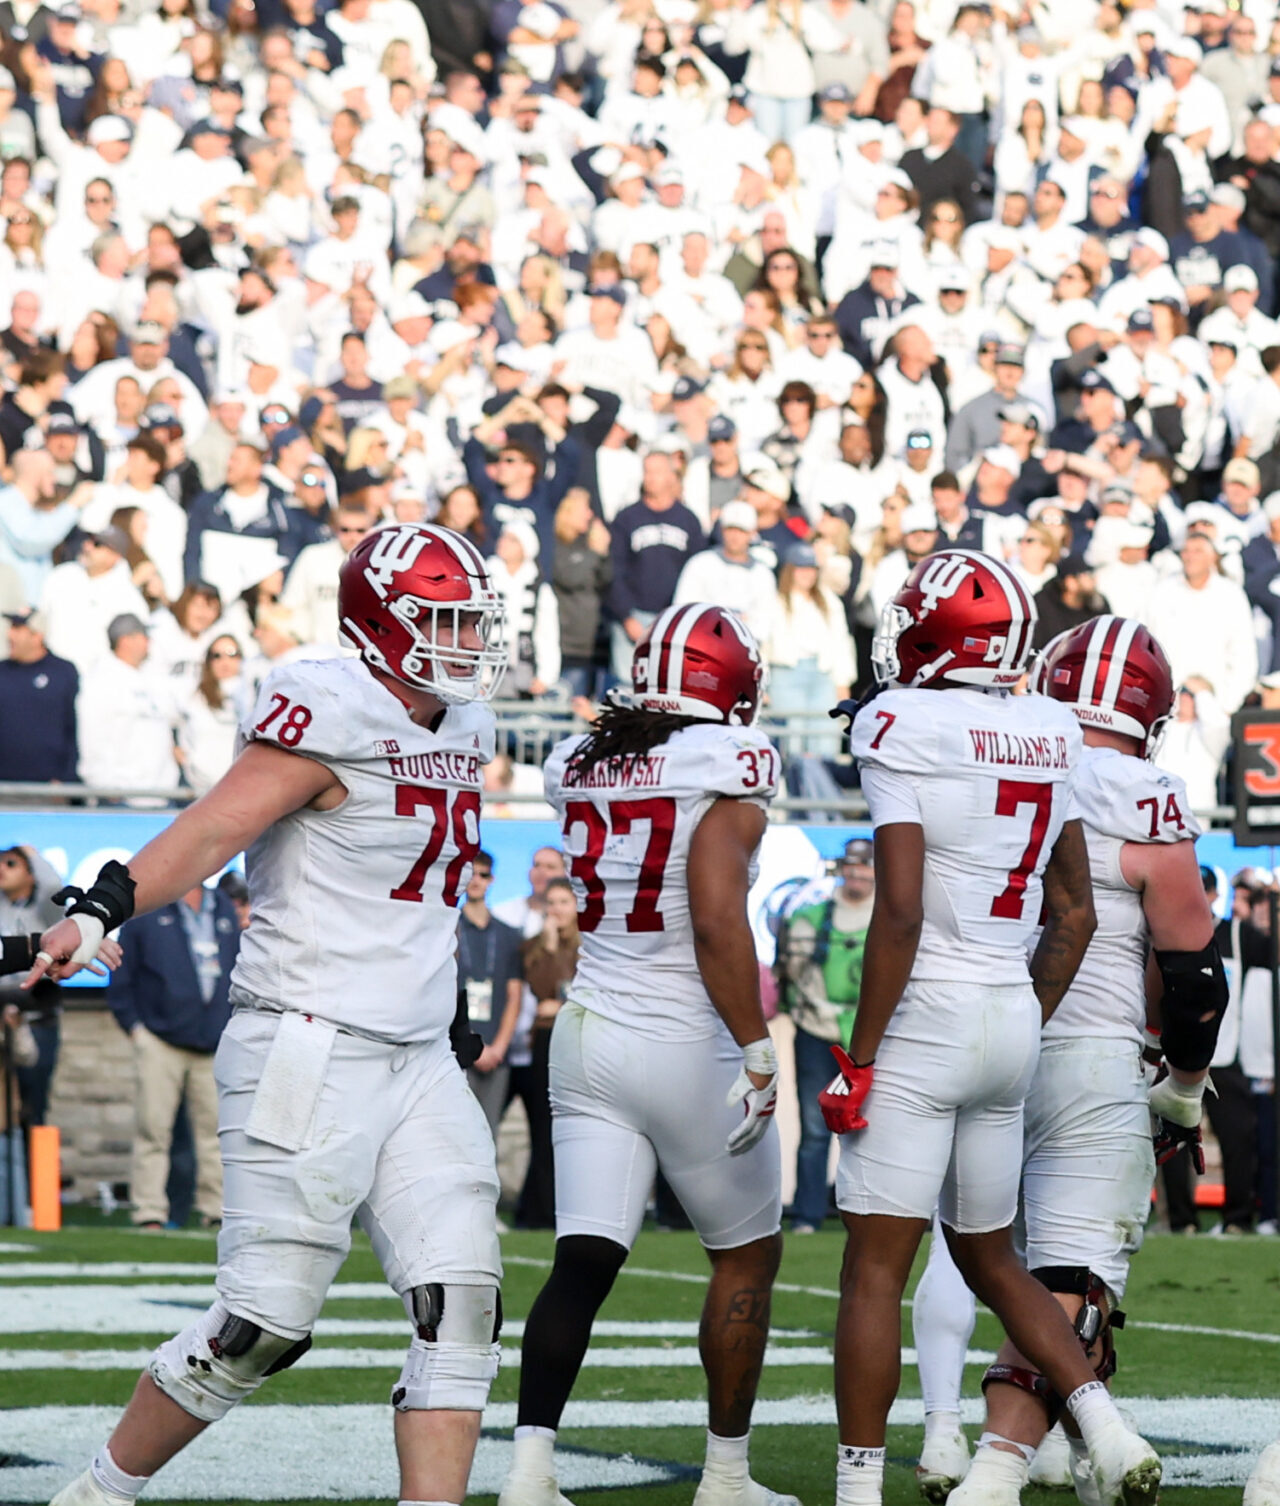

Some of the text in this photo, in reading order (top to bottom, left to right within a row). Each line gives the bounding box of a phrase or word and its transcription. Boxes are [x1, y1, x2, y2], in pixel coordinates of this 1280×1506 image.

[256, 693, 312, 747] 78
[870, 711, 897, 750] 7
[1071, 708, 1114, 726] NDIANA
[390, 753, 480, 783] HOOSIER
[737, 749, 775, 789] 37
[969, 729, 1052, 768] WILLIAMS
[1136, 793, 1186, 838] 74
[390, 784, 481, 908] 78
[563, 797, 677, 933] 37
[990, 779, 1053, 920] 7
